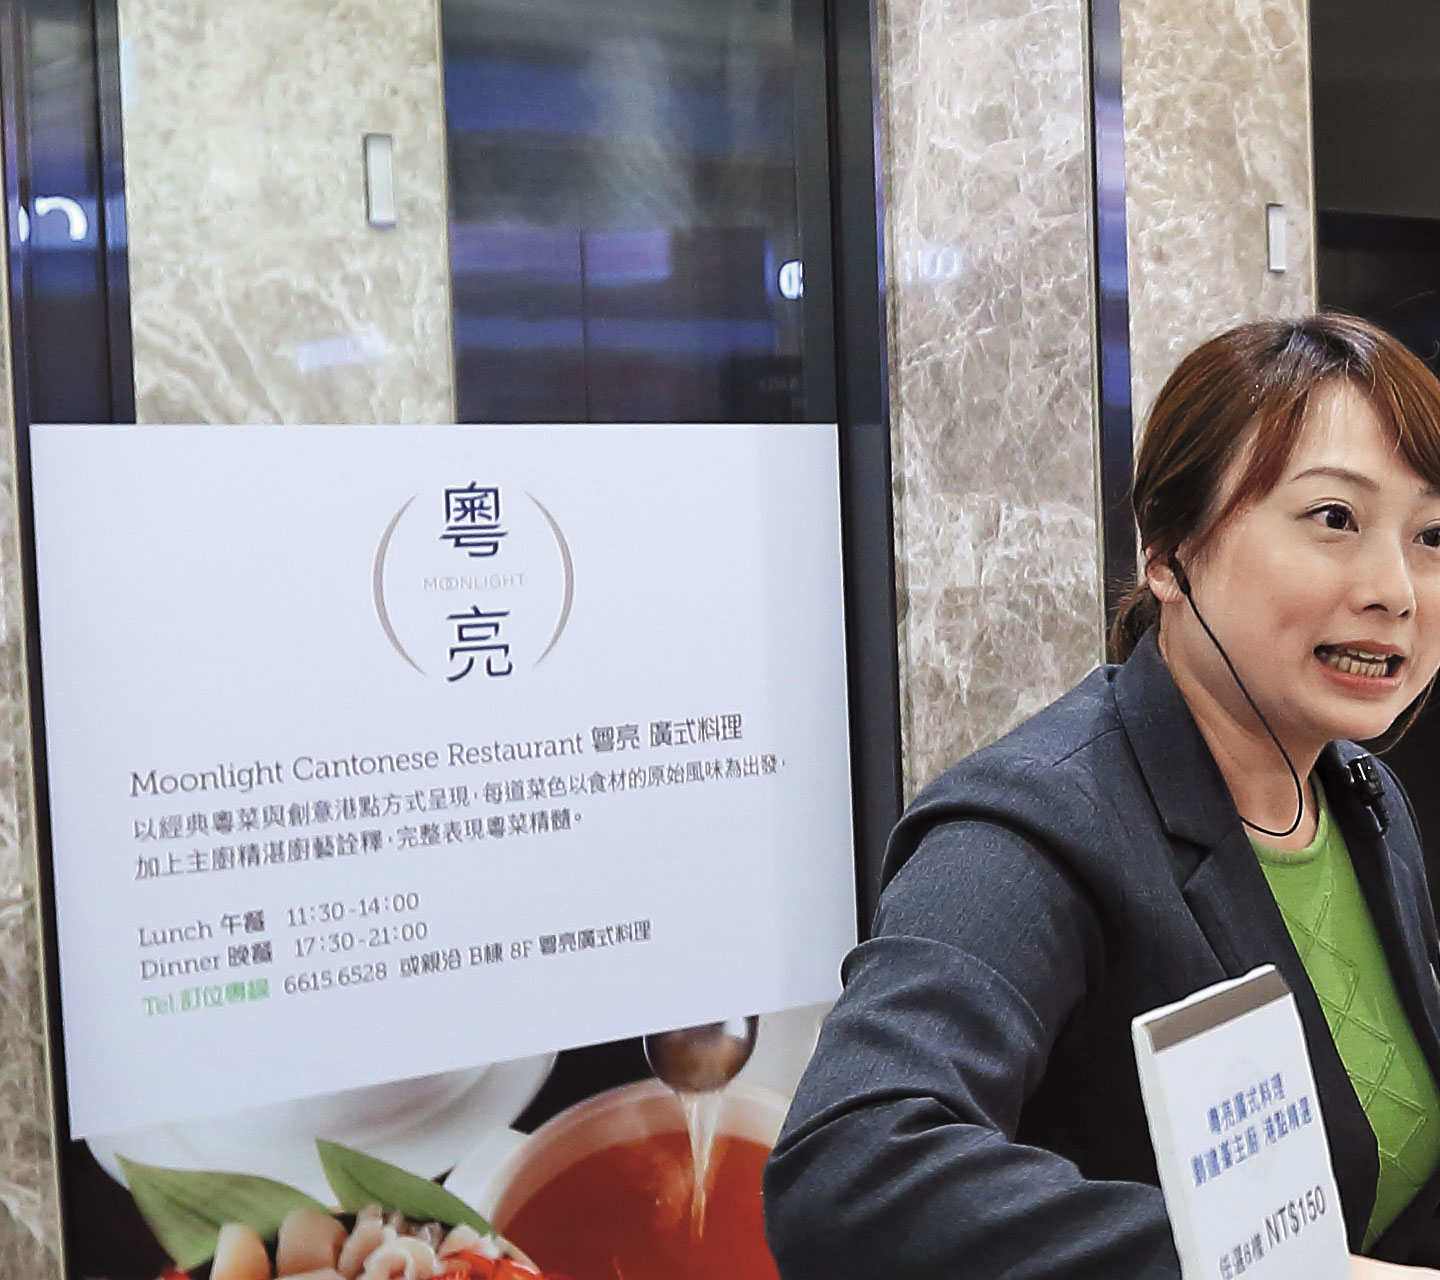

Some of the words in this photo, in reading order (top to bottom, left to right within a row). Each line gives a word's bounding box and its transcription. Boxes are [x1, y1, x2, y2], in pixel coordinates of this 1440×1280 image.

[423, 573, 527, 591] MOONLIGHT
[130, 760, 283, 798] Moonlight
[292, 749, 439, 781] Cantonese
[447, 733, 584, 767] Restaurant
[138, 920, 213, 947] Lunch
[510, 940, 533, 959] 8F
[141, 954, 220, 980] Dinner
[1265, 1185, 1327, 1250] NT$150
